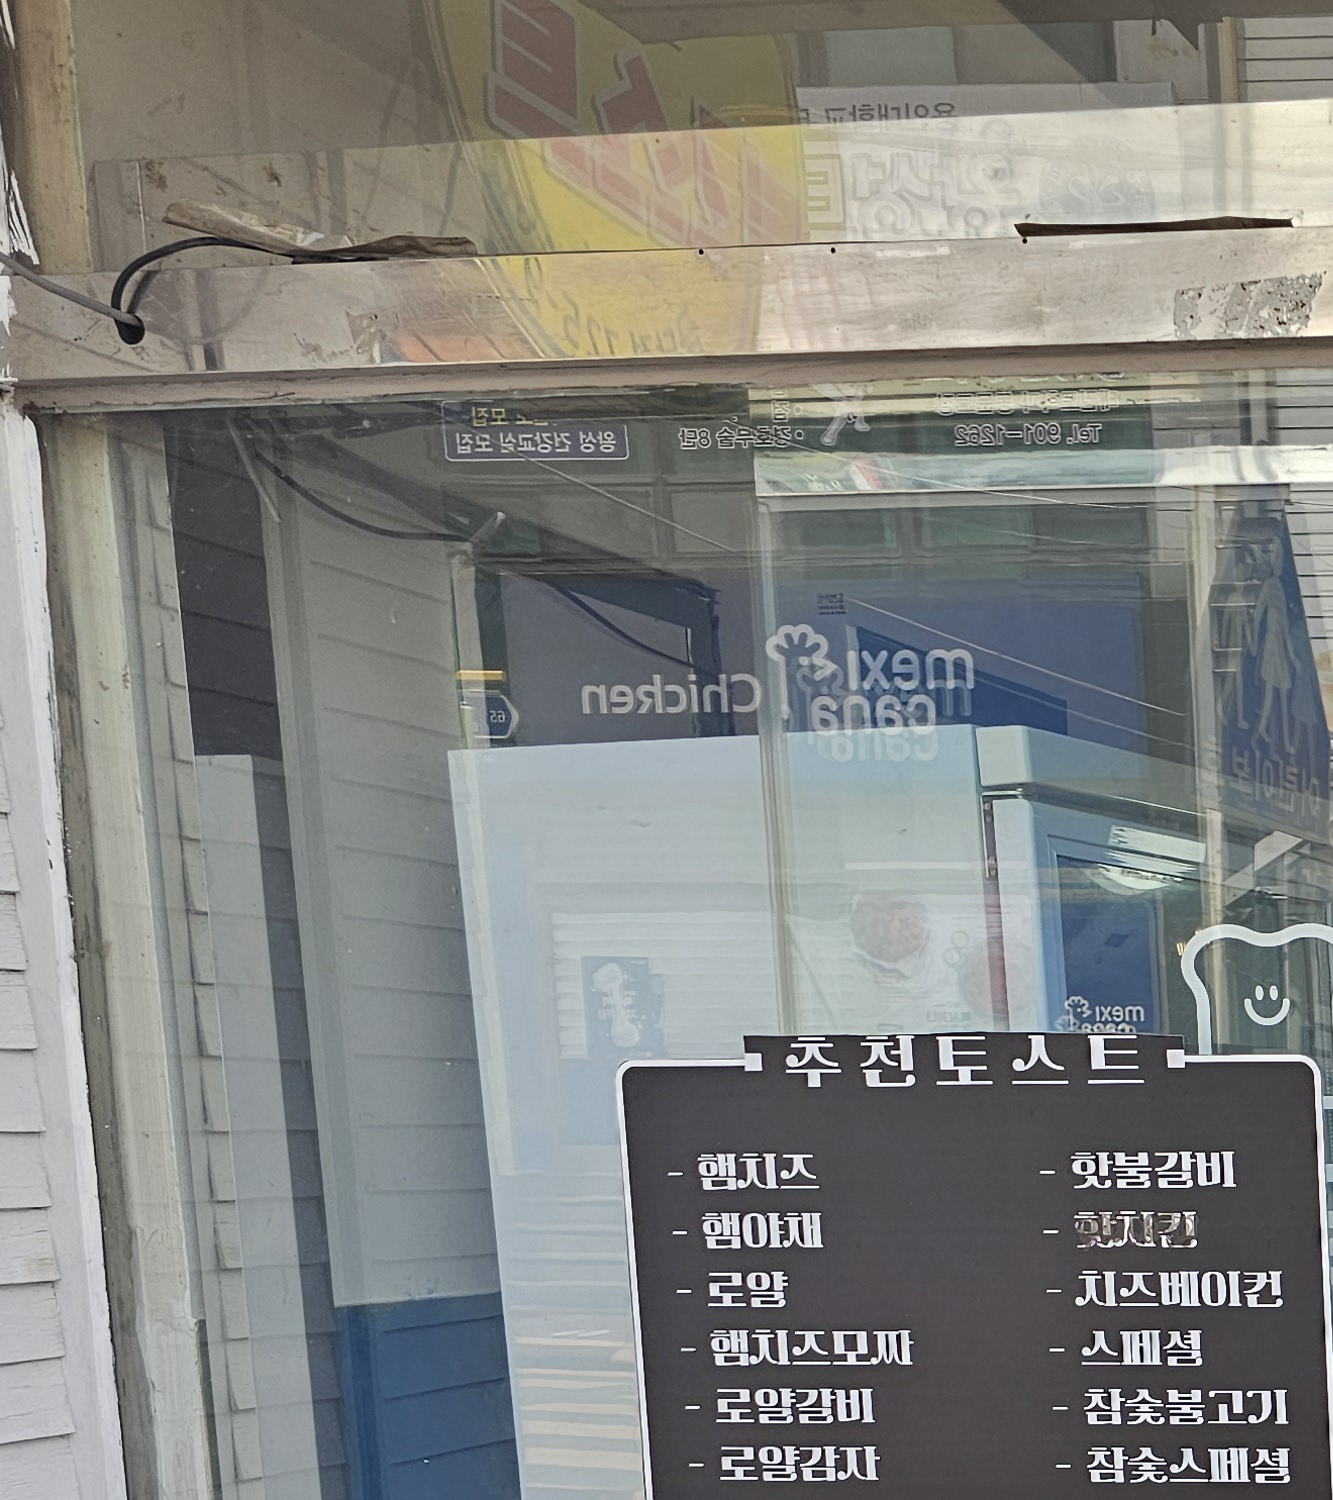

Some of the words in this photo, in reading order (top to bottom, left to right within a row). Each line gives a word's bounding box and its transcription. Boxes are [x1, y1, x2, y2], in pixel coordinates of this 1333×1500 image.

[784, 1034, 1148, 1088] 추천토스트
[697, 1152, 821, 1192] 햄치즈
[1070, 1150, 1238, 1190] 핫불갈비
[701, 1212, 824, 1250] 햄야채
[706, 1271, 789, 1309] 로얄
[1075, 1270, 1285, 1309] 치즈베이컨
[710, 1329, 914, 1368] 햄치즈모짜
[1081, 1329, 1204, 1368] 스페셜
[715, 1388, 876, 1426] 로얄갈비
[1082, 1387, 1290, 1427] 참숯불고기
[719, 1445, 880, 1483] 로얄감자
[1086, 1445, 1292, 1485] 참숯스페셜
